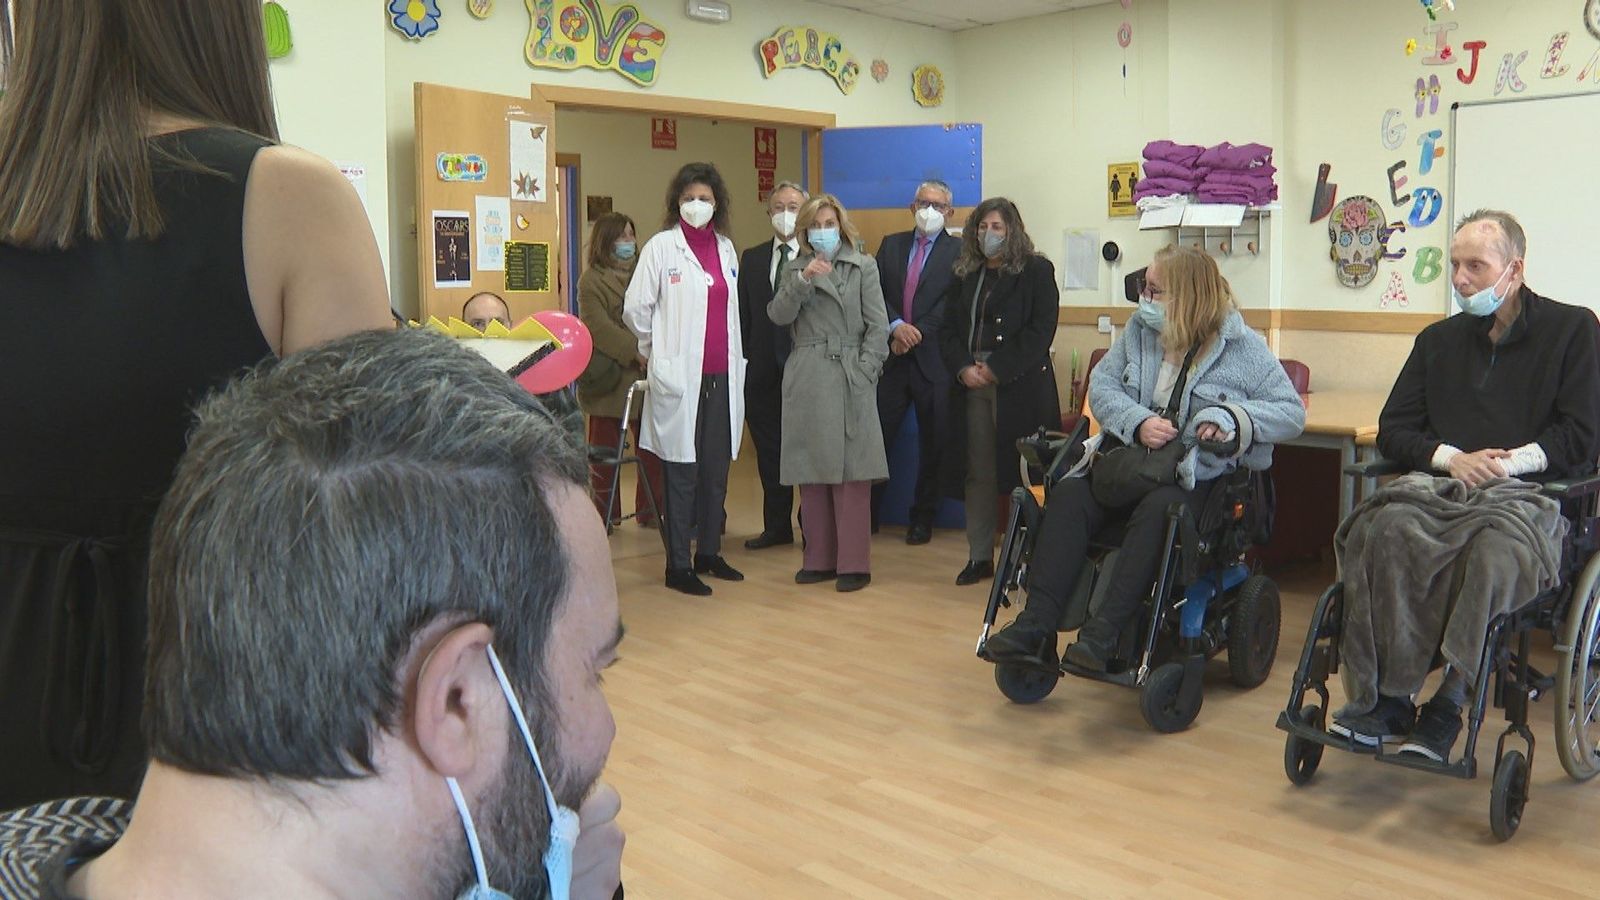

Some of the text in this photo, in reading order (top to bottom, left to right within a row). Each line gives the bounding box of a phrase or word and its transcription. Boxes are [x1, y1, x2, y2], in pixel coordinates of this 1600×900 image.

[533, 0, 666, 83] LOVE
[761, 28, 859, 87] PEACE
[1457, 40, 1487, 84] J
[1540, 31, 1570, 79] L
[1494, 50, 1528, 96] K
[1415, 74, 1441, 118] H
[1381, 108, 1407, 150] G
[1417, 129, 1445, 175] F
[1387, 160, 1411, 207] E
[435, 220, 469, 233] OSCARS
[1408, 187, 1443, 228] D
[1383, 221, 1406, 261] C
[1412, 246, 1443, 285] B
[1380, 271, 1410, 308] A
